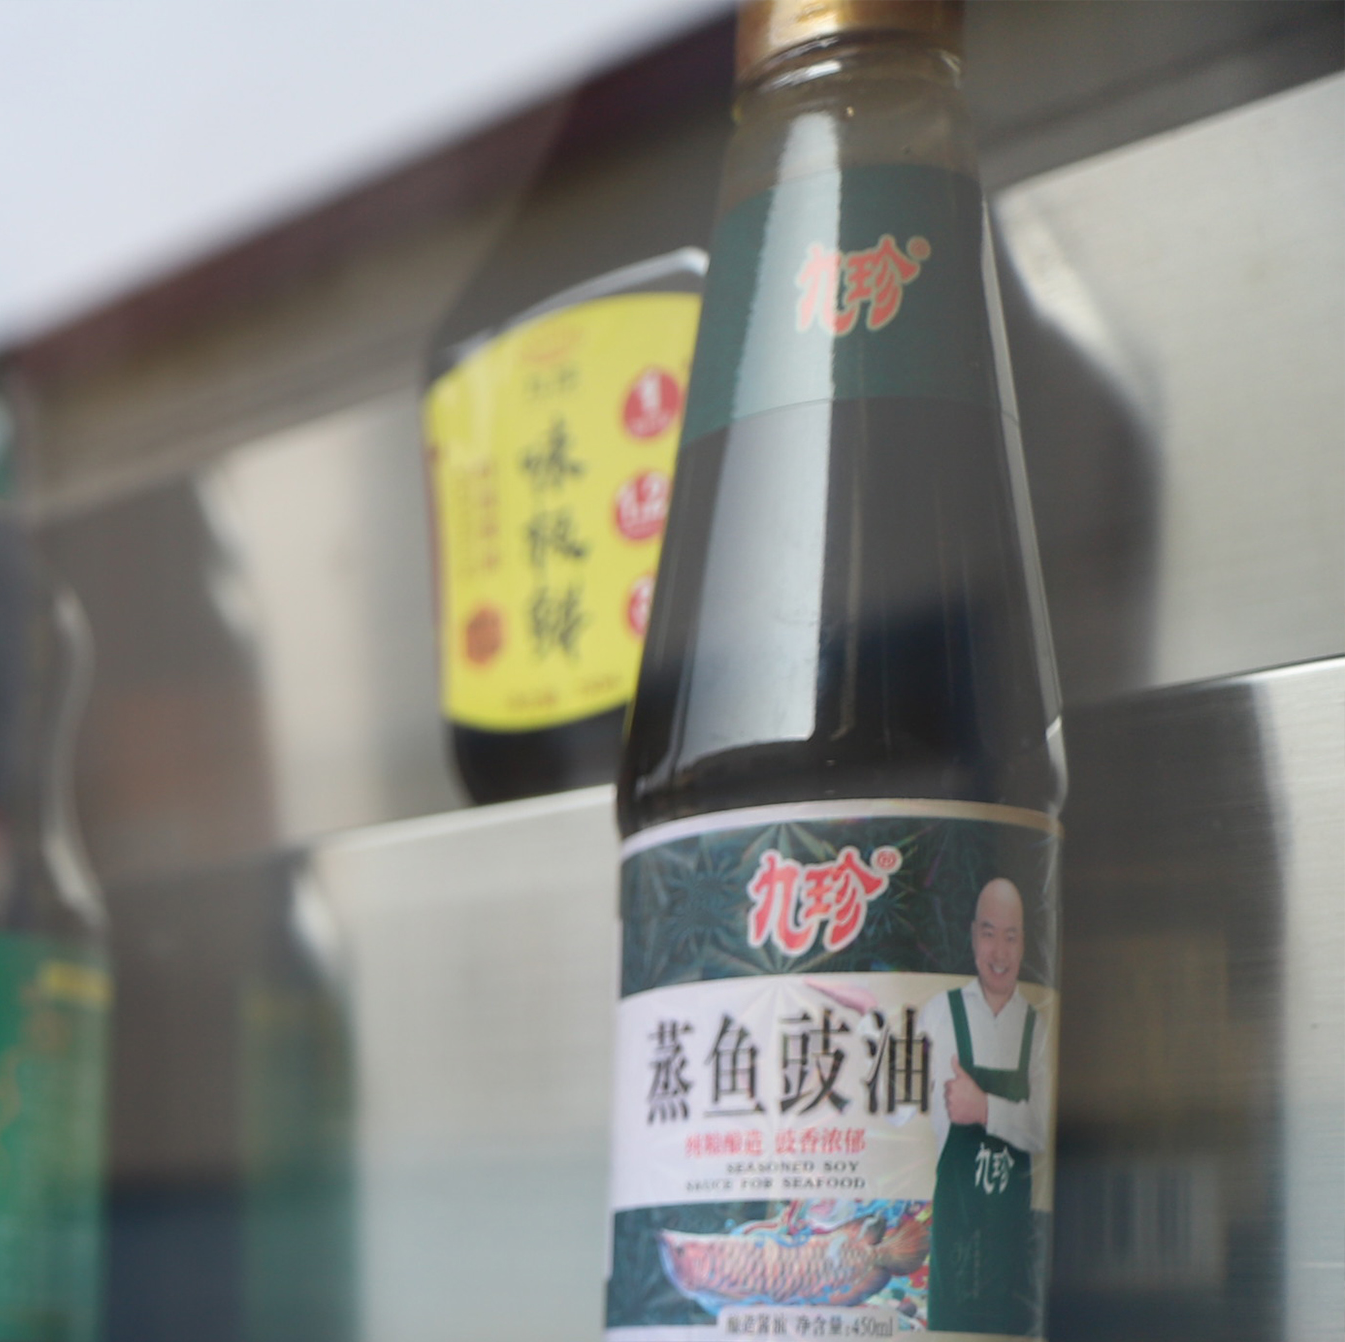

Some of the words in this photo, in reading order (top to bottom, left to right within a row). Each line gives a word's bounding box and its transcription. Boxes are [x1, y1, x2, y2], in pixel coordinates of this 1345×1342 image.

[794, 235, 920, 335] 九珍
[747, 847, 889, 957] 九珍
[646, 1004, 933, 1125] 蒸鱼豉油
[726, 1160, 815, 1174] SEASONED
[823, 1160, 859, 1173] SOY
[740, 1176, 773, 1189] FOR
[782, 1175, 866, 1190] SEAFOOD
[975, 1142, 1015, 1194] 九珍
